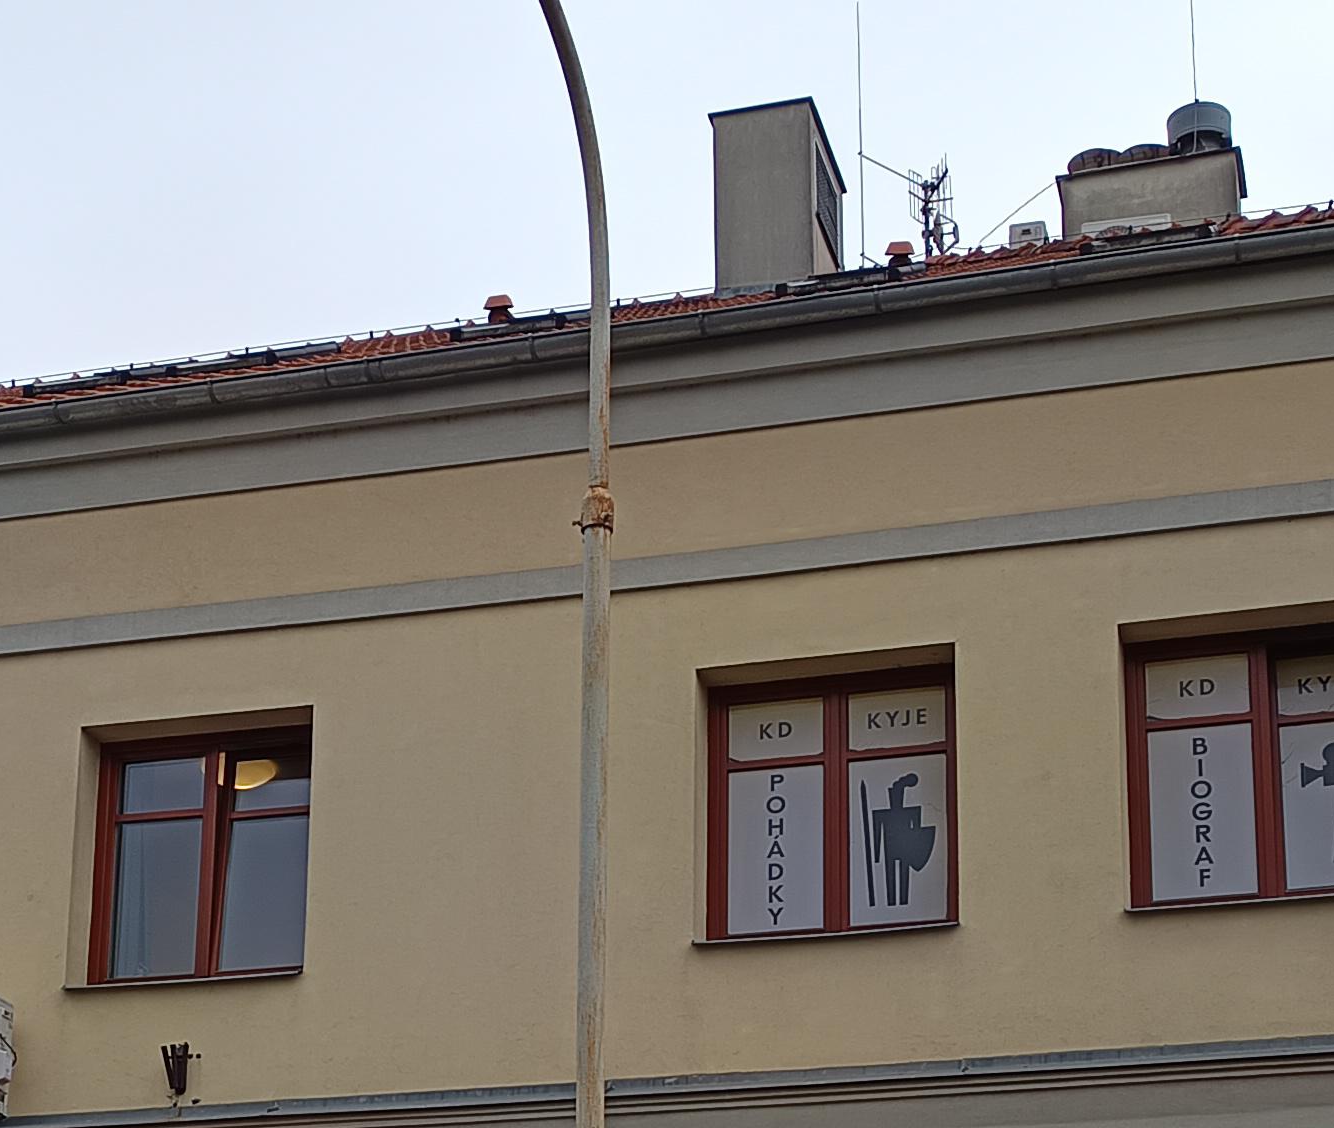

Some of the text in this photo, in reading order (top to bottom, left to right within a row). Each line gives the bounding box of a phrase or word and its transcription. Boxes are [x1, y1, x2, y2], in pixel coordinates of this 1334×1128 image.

[759, 708, 928, 740] KD KYJE
[1179, 678, 1215, 697] KD
[766, 774, 786, 925] POHÁDKY
[1190, 737, 1214, 888] BIOGRAF
